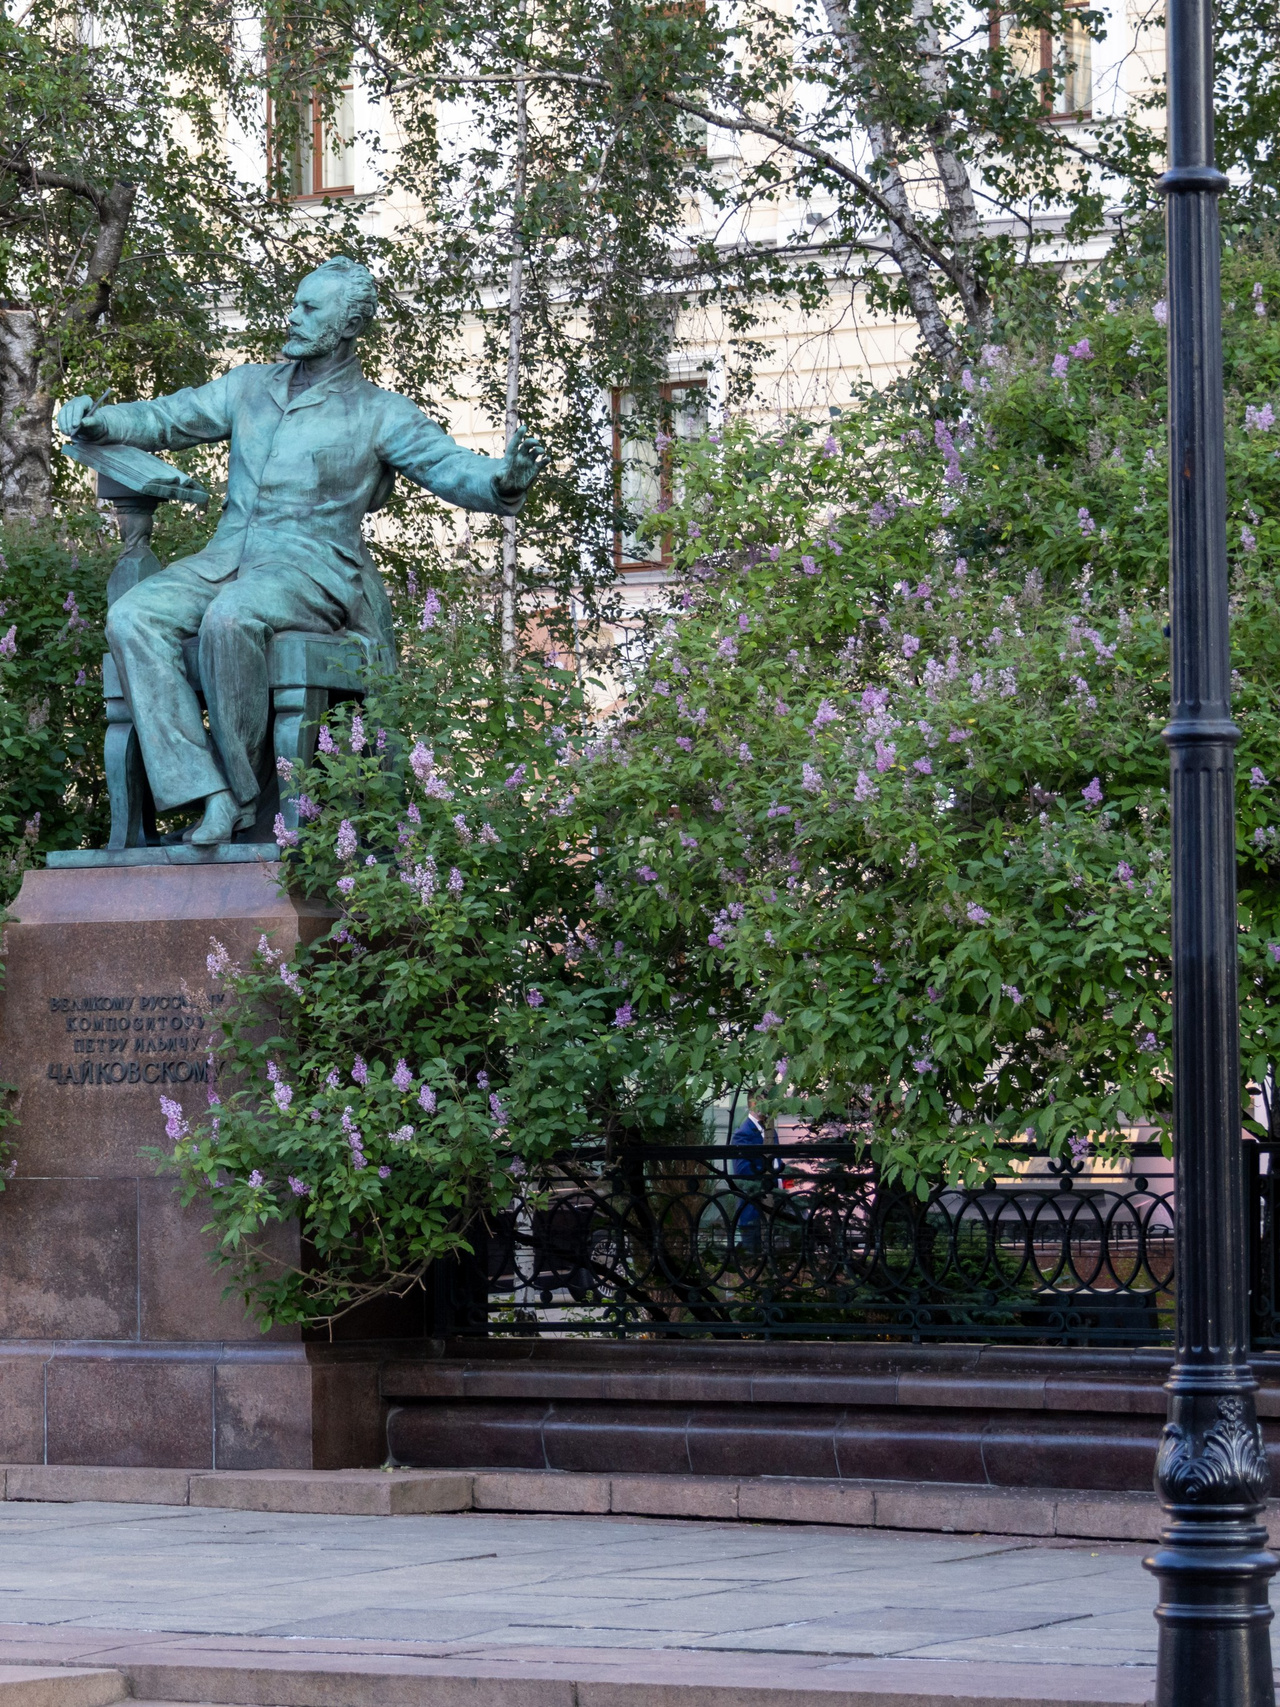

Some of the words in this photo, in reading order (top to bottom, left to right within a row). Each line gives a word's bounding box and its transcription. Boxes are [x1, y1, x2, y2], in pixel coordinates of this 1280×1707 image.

[49, 996, 135, 1012] ВЕЛИКОМУ
[66, 1016, 205, 1032] КОМПОЗИТОРУ
[74, 1038, 128, 1053] ПЕТРУ
[134, 1037, 201, 1053] ИЛЬИЧУ
